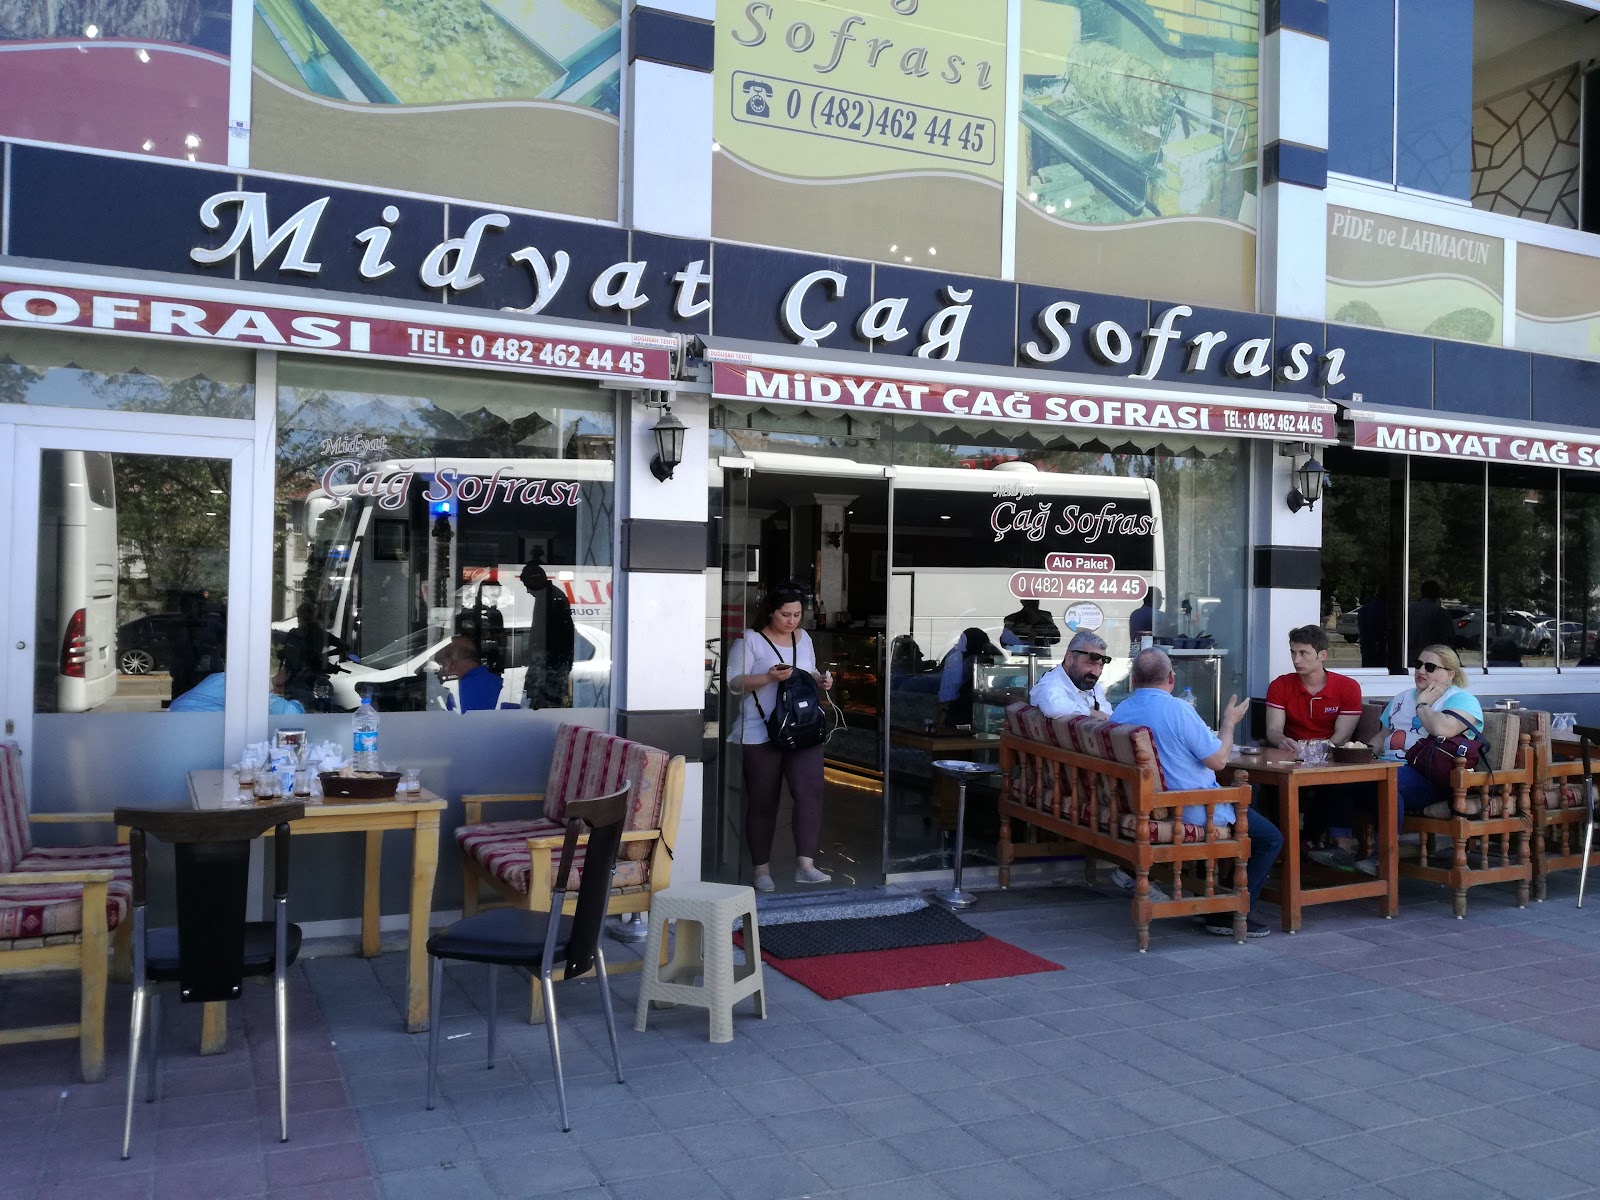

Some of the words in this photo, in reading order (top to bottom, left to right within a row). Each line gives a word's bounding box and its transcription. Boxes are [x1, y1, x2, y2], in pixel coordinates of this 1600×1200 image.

[731, 1, 993, 90] Sofrası
[786, 88, 802, 119] 0
[924, 115, 952, 147] 44
[958, 121, 986, 152] 45
[1331, 209, 1375, 242] PİDE
[1377, 227, 1397, 247] ve
[1400, 226, 1490, 265] LAHMACUN
[190, 190, 712, 318] Midyat
[783, 269, 974, 362] Çağ
[1021, 300, 1346, 385] Sofrası
[470, 335, 484, 358] 0
[491, 337, 533, 363] 482
[540, 342, 580, 368] 462
[586, 347, 613, 371] 44
[619, 350, 645, 373] 45
[1045, 397, 1211, 429] SOFRASI
[1249, 412, 1256, 429] 0
[1257, 413, 1276, 431] 482
[1277, 414, 1295, 432] 462
[1296, 415, 1310, 433] 44
[1311, 416, 1323, 433] 45
[321, 434, 388, 458] Midyat
[321, 460, 415, 510] Çağ
[422, 466, 582, 514] Sofrası
[990, 501, 1052, 542] Çağ
[1055, 502, 1159, 543] Sofrası
[1052, 557, 1073, 569] Alo
[1075, 557, 1109, 570] Paket
[1018, 577, 1027, 592] 0
[1030, 576, 1064, 596] (482)
[1066, 578, 1095, 593] 462
[1099, 579, 1118, 594] 44
[1121, 580, 1140, 595] 45
